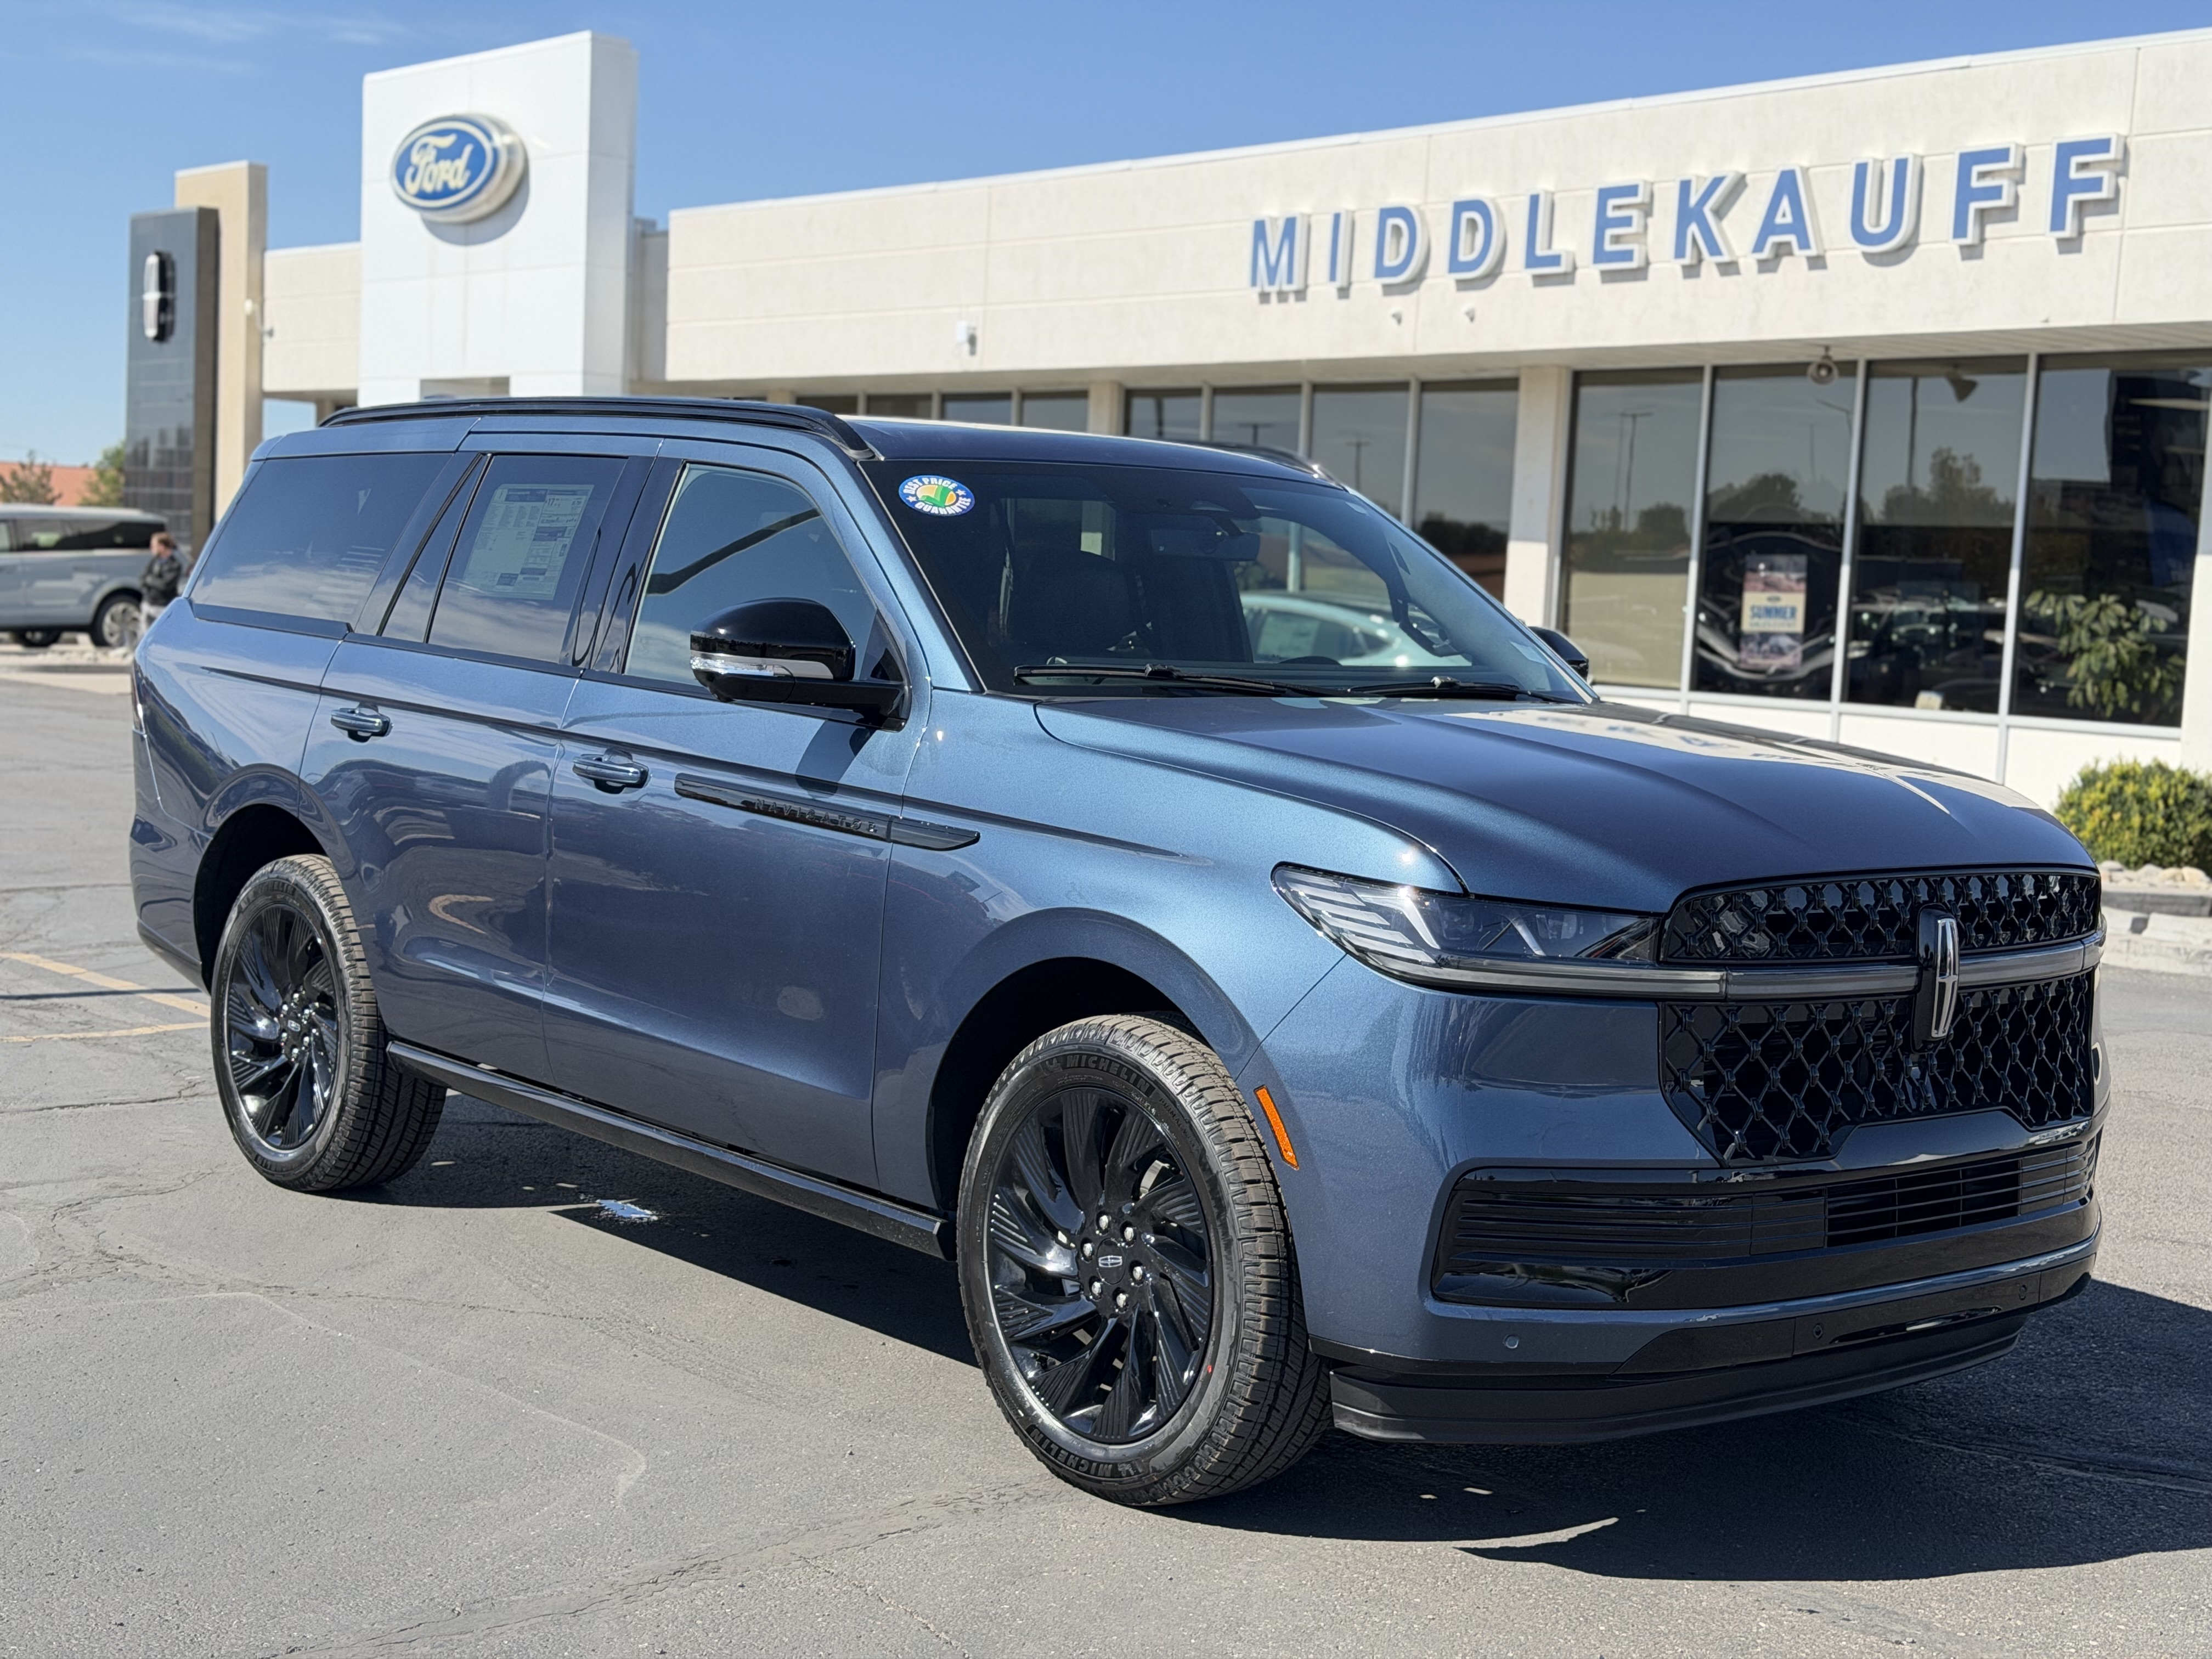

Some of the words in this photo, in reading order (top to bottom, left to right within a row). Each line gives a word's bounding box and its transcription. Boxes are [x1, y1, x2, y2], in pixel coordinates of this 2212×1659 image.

[404, 133, 474, 196] Ford
[1250, 133, 2122, 294] MIDDLEKAUFF
[903, 478, 923, 494] BEST
[922, 477, 958, 490] PRICE
[915, 496, 972, 515] GUARANTEE
[1750, 605, 1797, 619] SUMMER
[754, 798, 877, 833] NAVIGATOR
[1066, 1054, 1150, 1095] MICHELIN
[1029, 1427, 1113, 1477] MICHELIN
